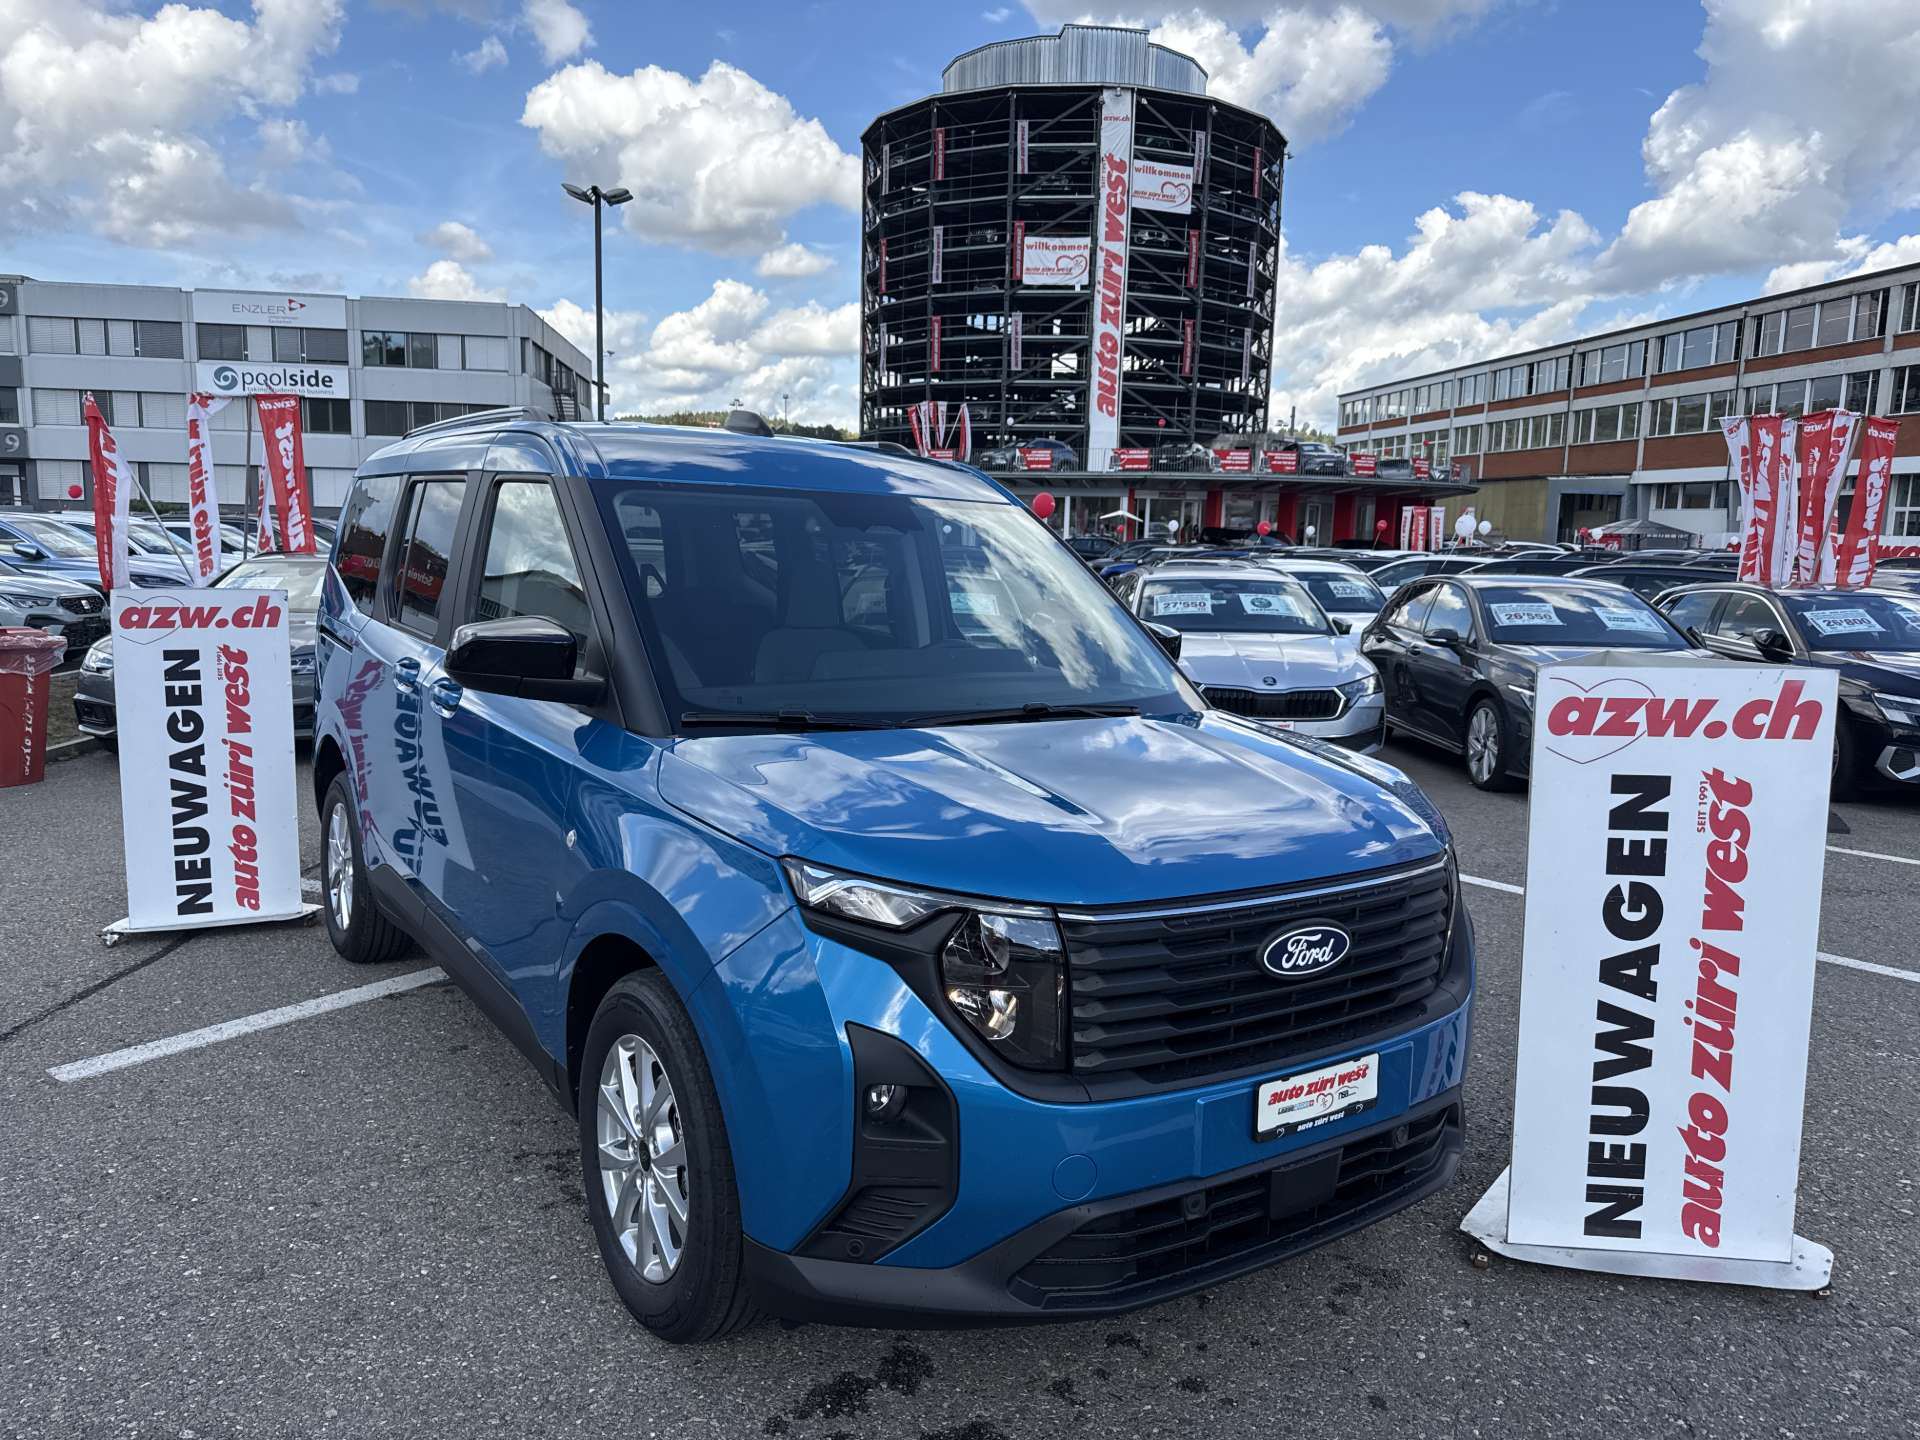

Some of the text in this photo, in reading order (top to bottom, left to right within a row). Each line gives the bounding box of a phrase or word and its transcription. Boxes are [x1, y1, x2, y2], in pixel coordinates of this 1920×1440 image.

[1103, 114, 1130, 122] azw.ch
[1134, 165, 1192, 180] willkommen
[1025, 241, 1089, 251] willkommen
[1096, 152, 1127, 418] auto züri west
[232, 303, 287, 315] ENZLER
[241, 367, 334, 391] poolside
[4, 434, 20, 453] 9
[119, 596, 281, 630] azw.ch
[1547, 680, 1824, 741] azw.ch
[163, 649, 214, 916] NEUWAGEN
[216, 643, 260, 911] auto züri west
[1697, 780, 1709, 833] SEIT 1991
[1281, 933, 1335, 969] Ford
[1583, 774, 1672, 1239] NEUWAGEN
[1677, 767, 1753, 1249] auto züri west
[1267, 1084, 1304, 1106] auto
[1304, 1073, 1337, 1097] züri
[1338, 1063, 1370, 1087] west
[1297, 1121, 1313, 1132] auto
